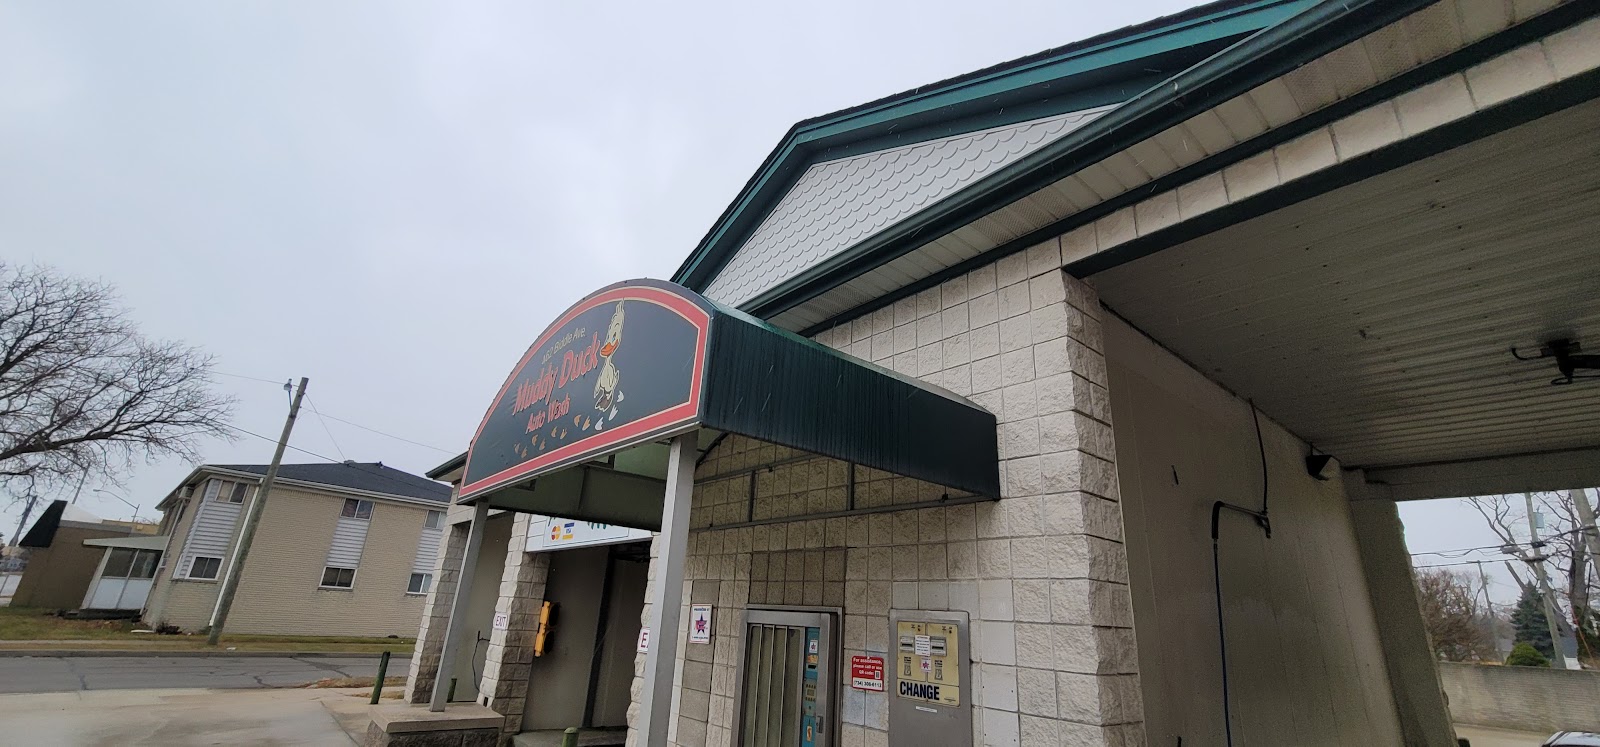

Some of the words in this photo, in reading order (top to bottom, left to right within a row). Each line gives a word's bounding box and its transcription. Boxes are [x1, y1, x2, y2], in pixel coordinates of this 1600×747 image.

[553, 333, 572, 354] Biddle
[512, 362, 559, 416] Muddy
[558, 330, 601, 389] Duck
[525, 410, 546, 434] Auto
[547, 392, 571, 424] Wash
[496, 616, 506, 627] EXIT
[900, 681, 940, 700] CHANGE
